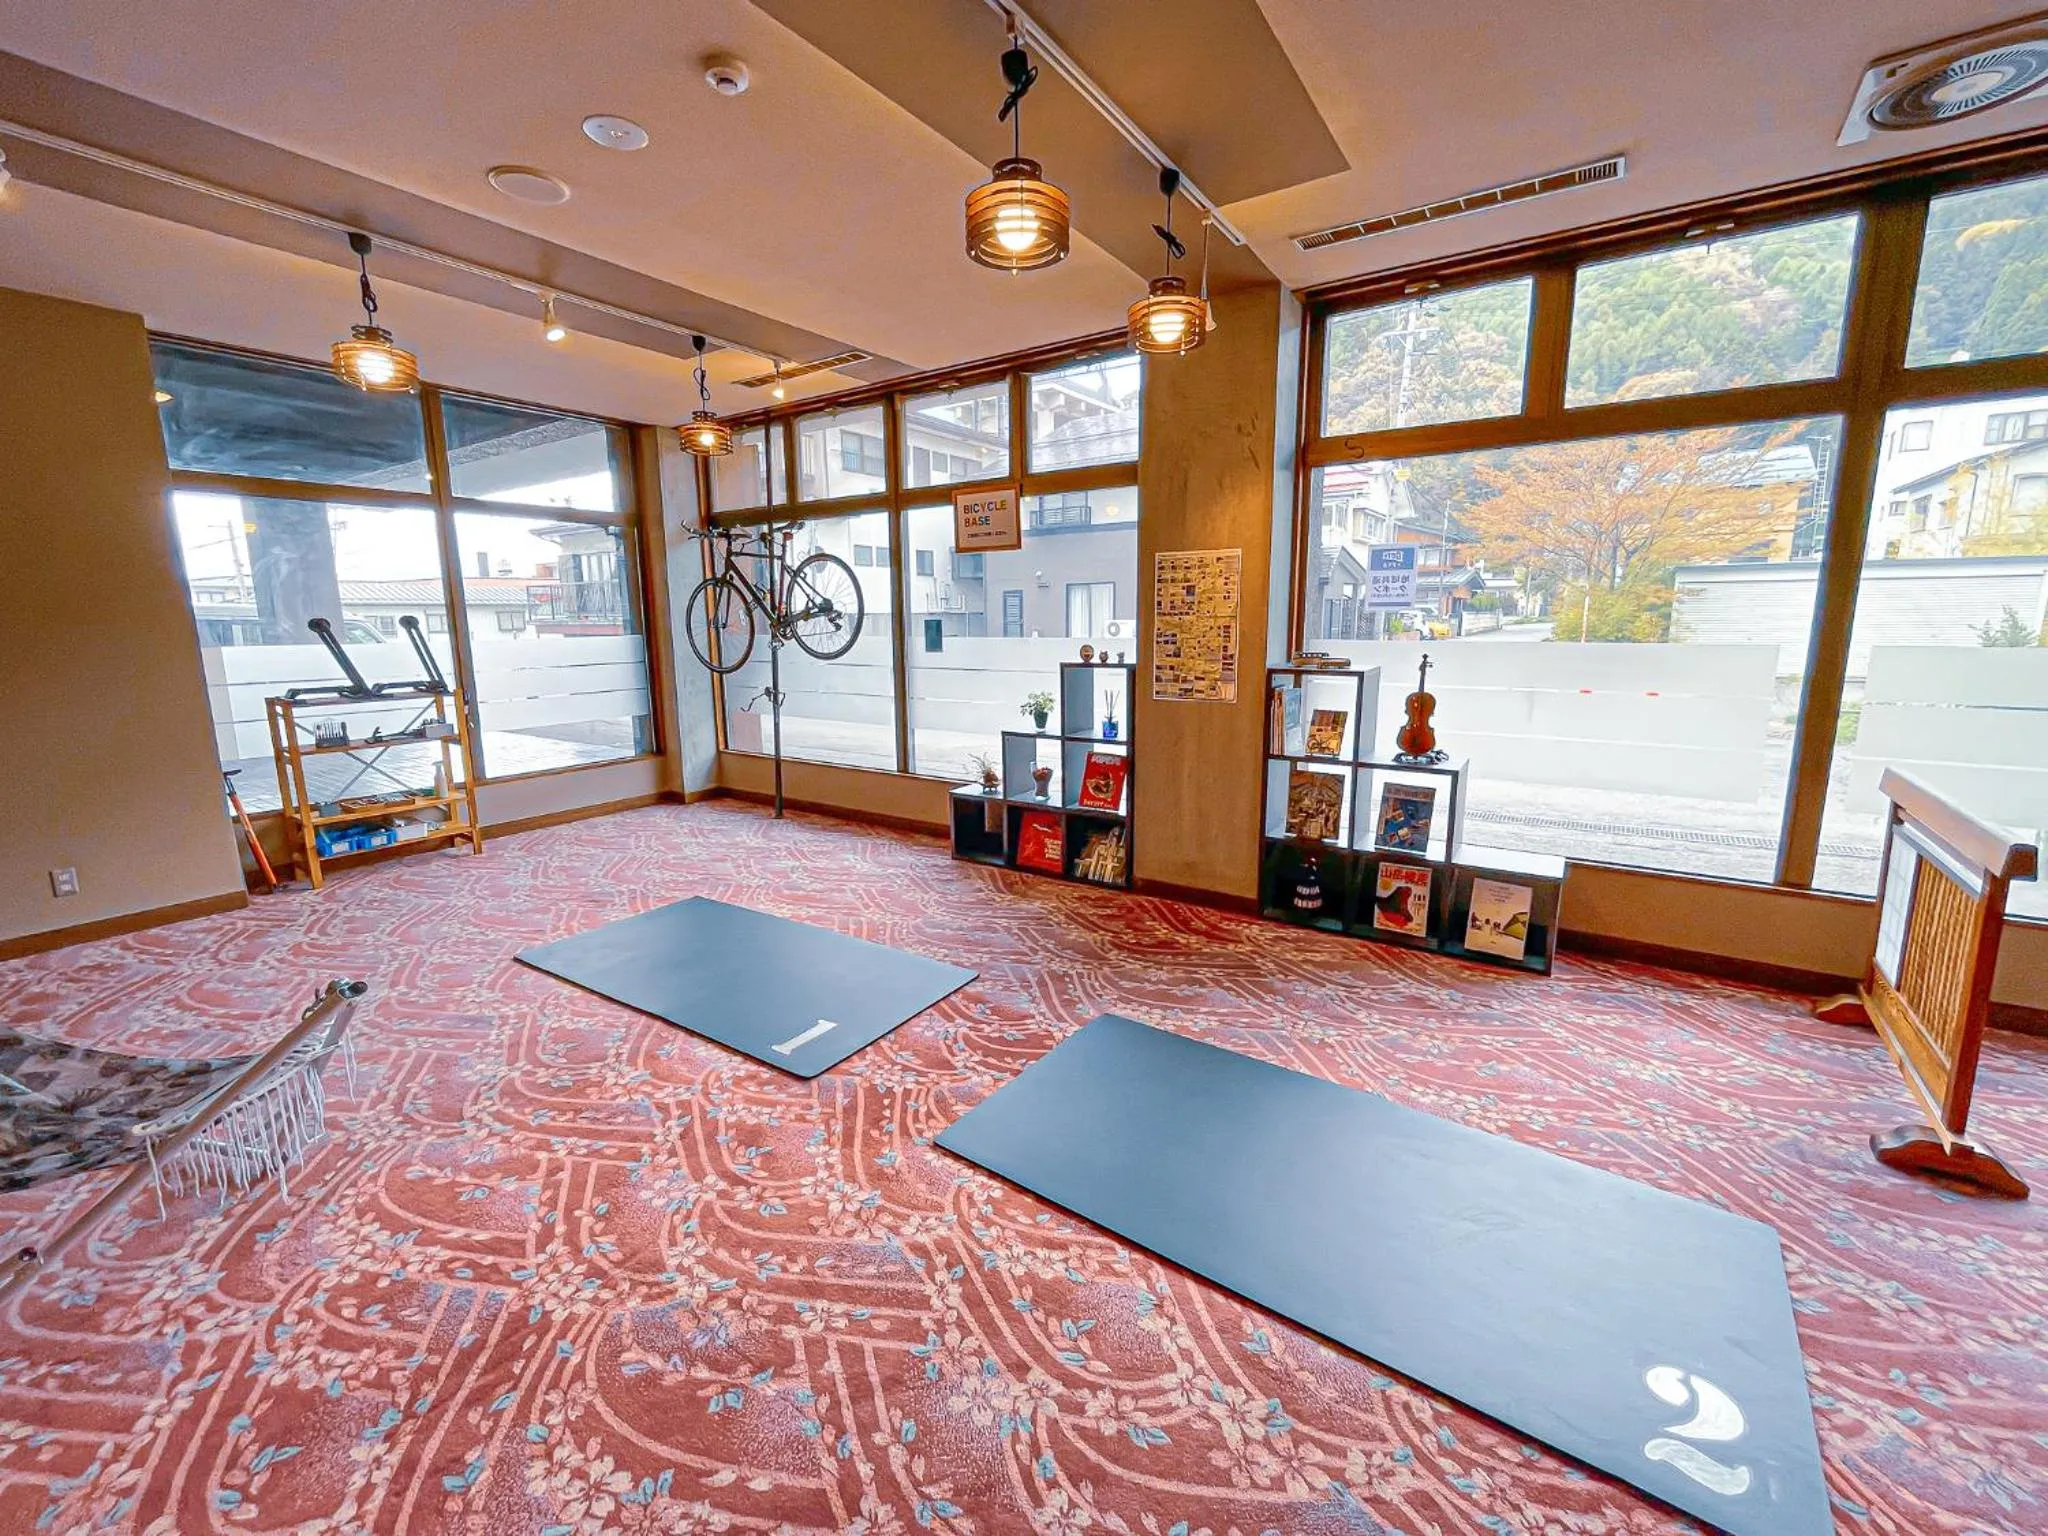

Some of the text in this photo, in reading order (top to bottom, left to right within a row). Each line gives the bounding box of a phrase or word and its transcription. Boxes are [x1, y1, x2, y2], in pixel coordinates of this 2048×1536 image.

[963, 500, 1007, 514] BICYCLE
[964, 516, 990, 527] BASE
[770, 1019, 839, 1055] 1
[1644, 1366, 1750, 1496] 2
